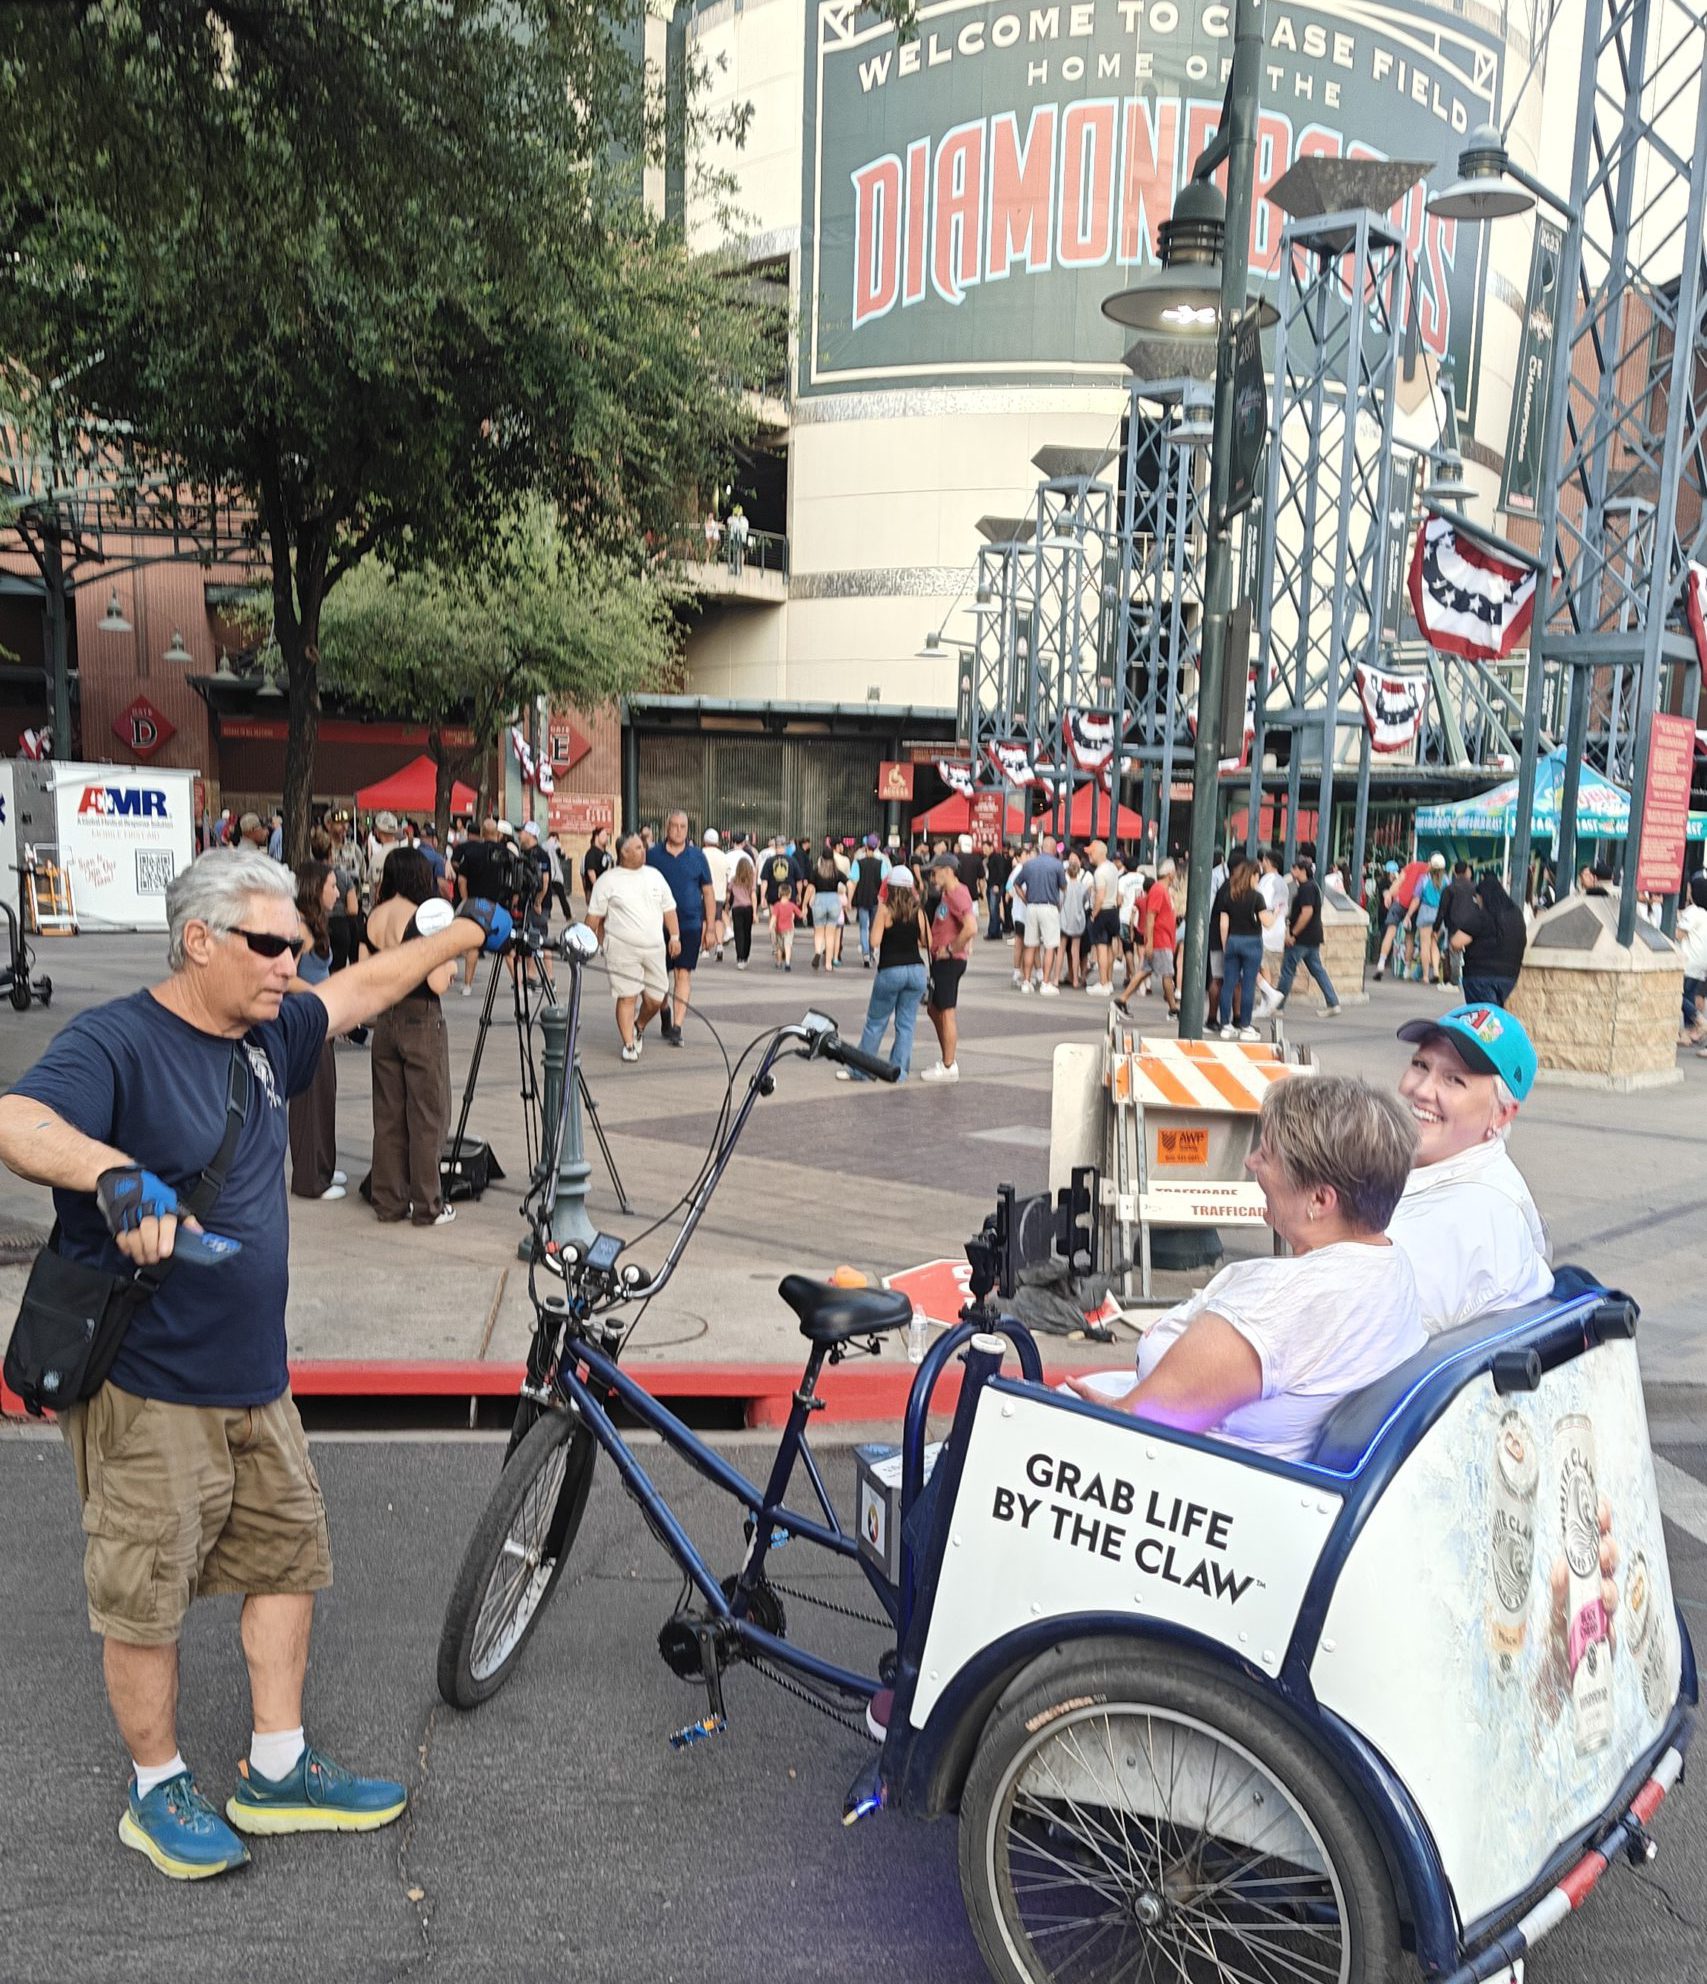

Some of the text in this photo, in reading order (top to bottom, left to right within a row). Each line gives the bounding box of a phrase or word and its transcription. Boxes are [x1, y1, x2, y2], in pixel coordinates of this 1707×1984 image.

[858, 1, 1468, 134] WELCOME TO CASE FIELD
[1027, 52, 1153, 86] HOME
[1267, 64, 1341, 109] THE
[131, 716, 158, 749] D
[550, 734, 571, 766] E
[78, 786, 168, 818] AMR
[1026, 1453, 1234, 1551] GRAB LIFE
[992, 1486, 1043, 1529] BY
[1050, 1504, 1126, 1562] THE
[1135, 1538, 1255, 1605] CLAW
